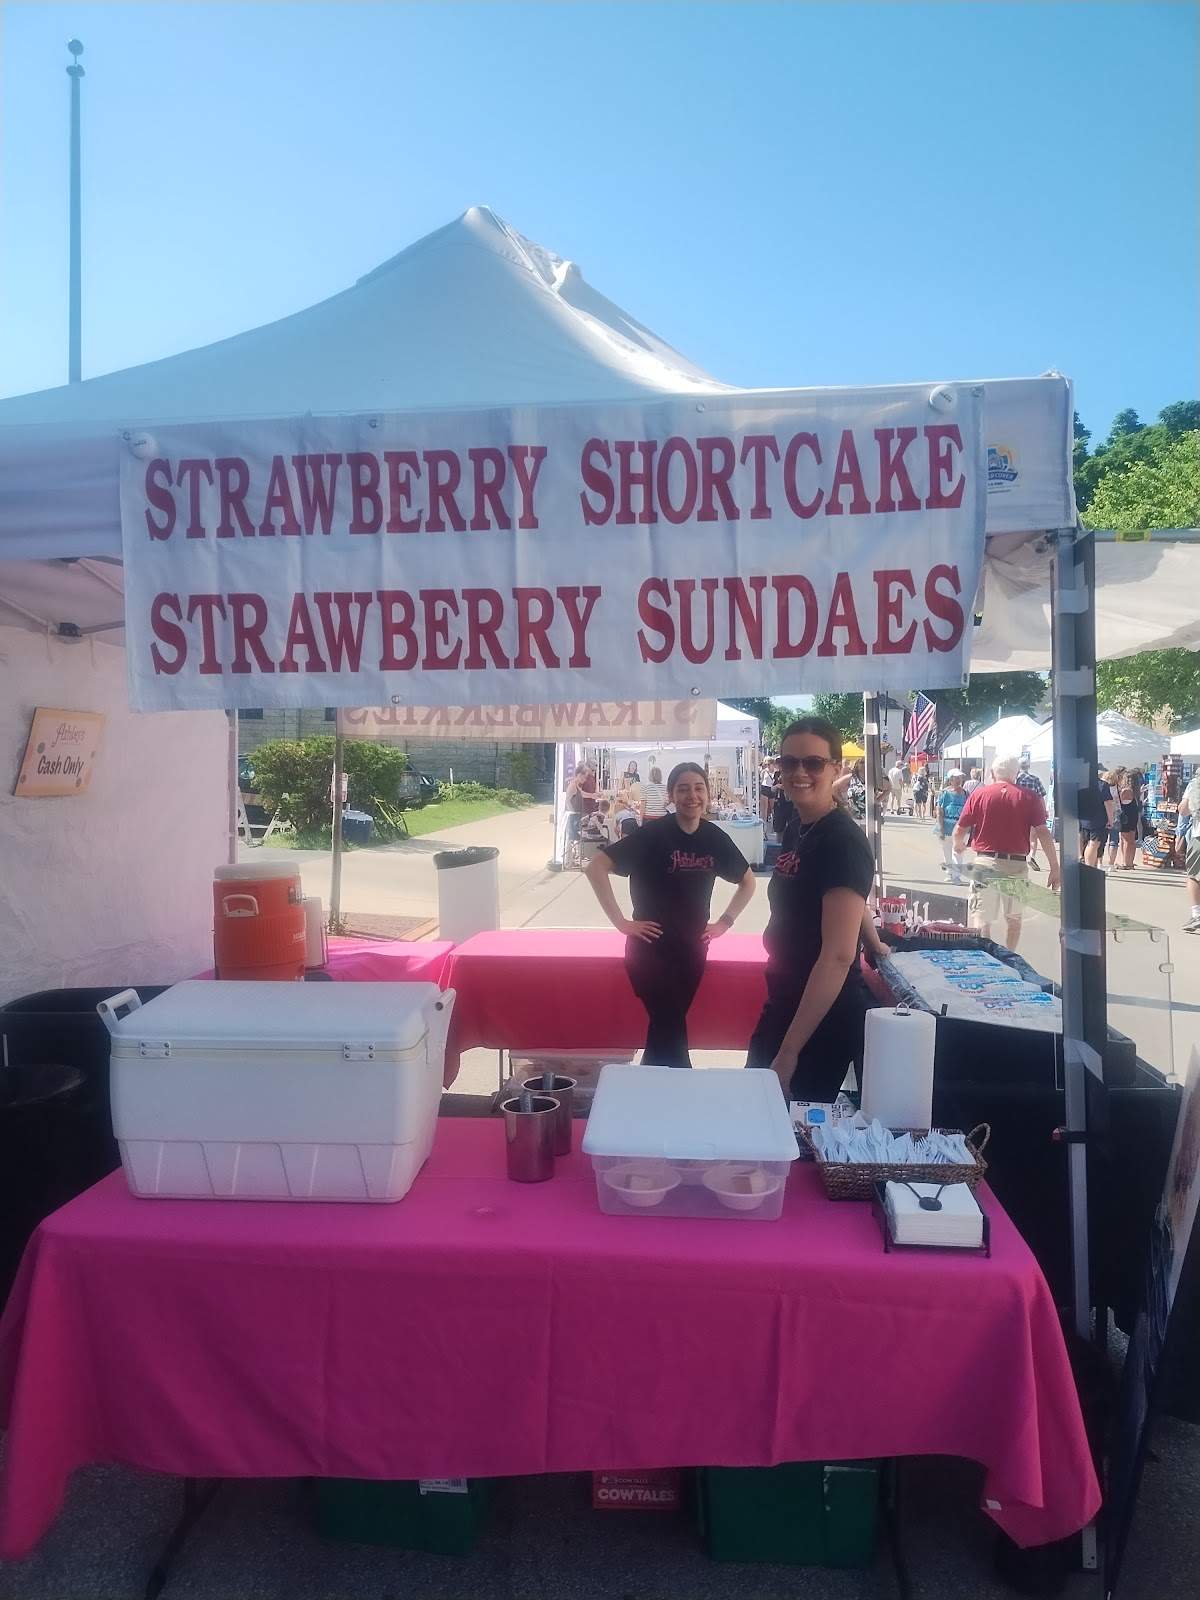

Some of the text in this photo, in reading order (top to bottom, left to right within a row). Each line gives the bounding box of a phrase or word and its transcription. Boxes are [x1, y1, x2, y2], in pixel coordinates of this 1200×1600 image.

[145, 423, 966, 541] STRAWBERRY SHORTCAKE
[150, 563, 965, 676] STRAWBERRY SUNDAES
[37, 754, 84, 777] Cash Only
